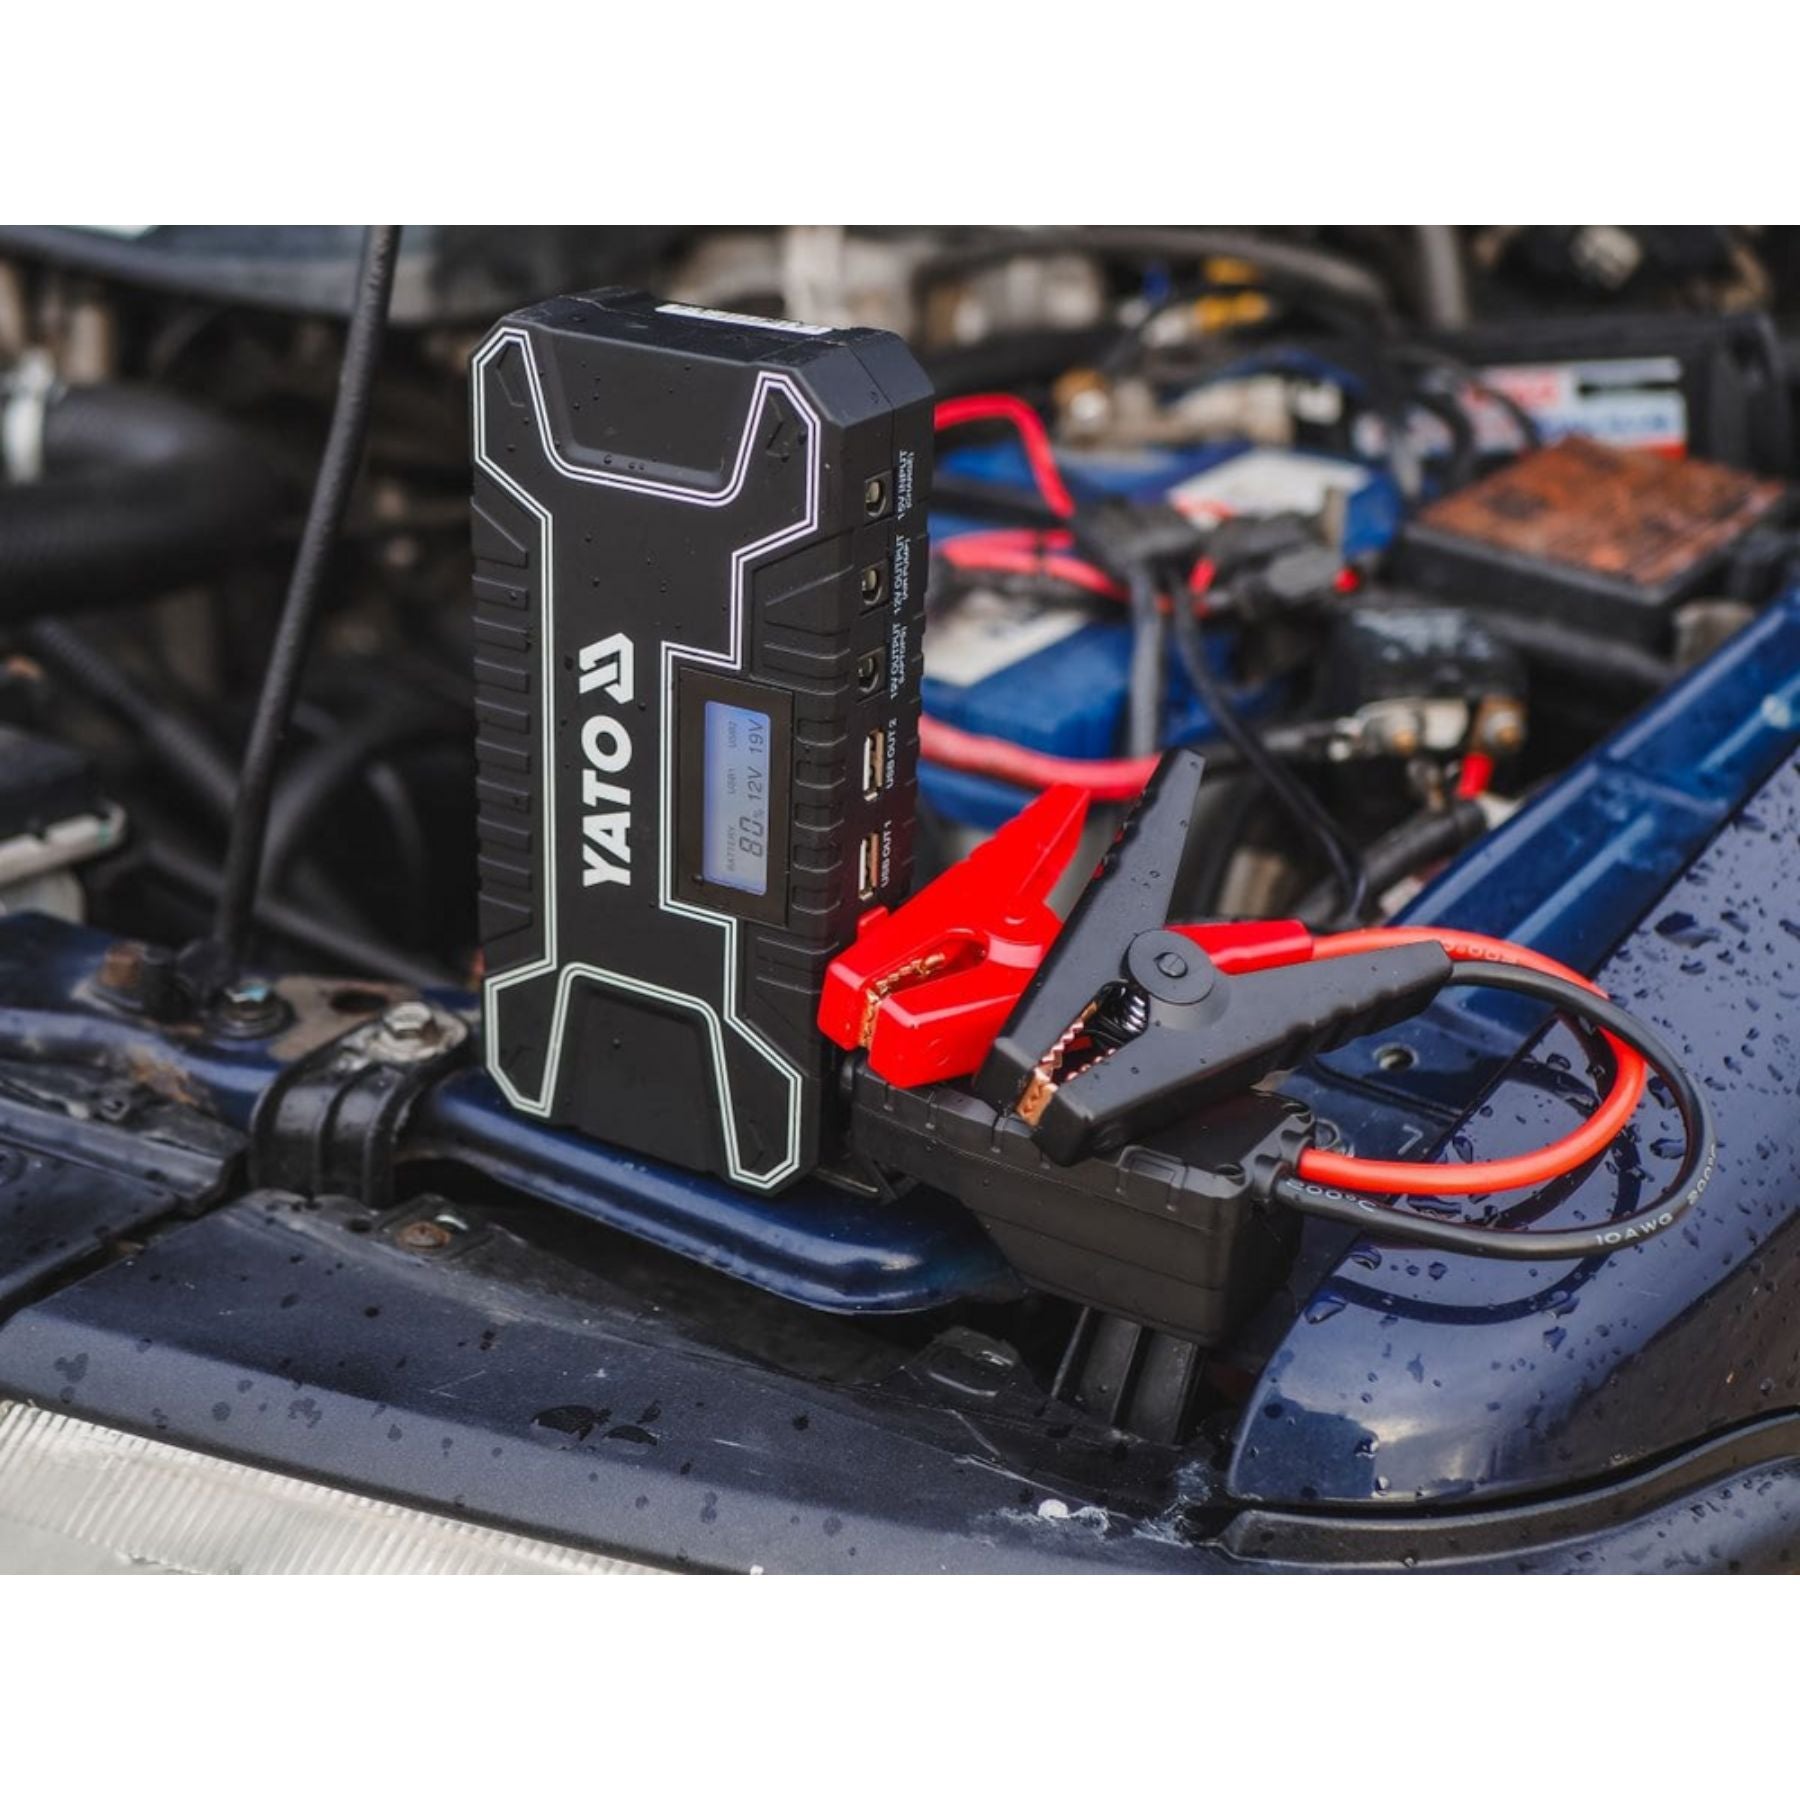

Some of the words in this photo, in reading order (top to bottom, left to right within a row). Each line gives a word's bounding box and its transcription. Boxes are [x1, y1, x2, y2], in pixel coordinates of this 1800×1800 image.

[897, 450, 908, 494] INPUT
[894, 534, 905, 589] OUTPUT
[890, 624, 901, 675] OUTPUT
[748, 718, 764, 754] 19V
[887, 730, 897, 758] OUT
[747, 766, 763, 801] 12V
[886, 759, 896, 789] USB
[581, 715, 633, 888] YATO
[727, 825, 738, 871] BATTERY
[883, 830, 892, 857] OUT
[880, 858, 891, 888] USB
